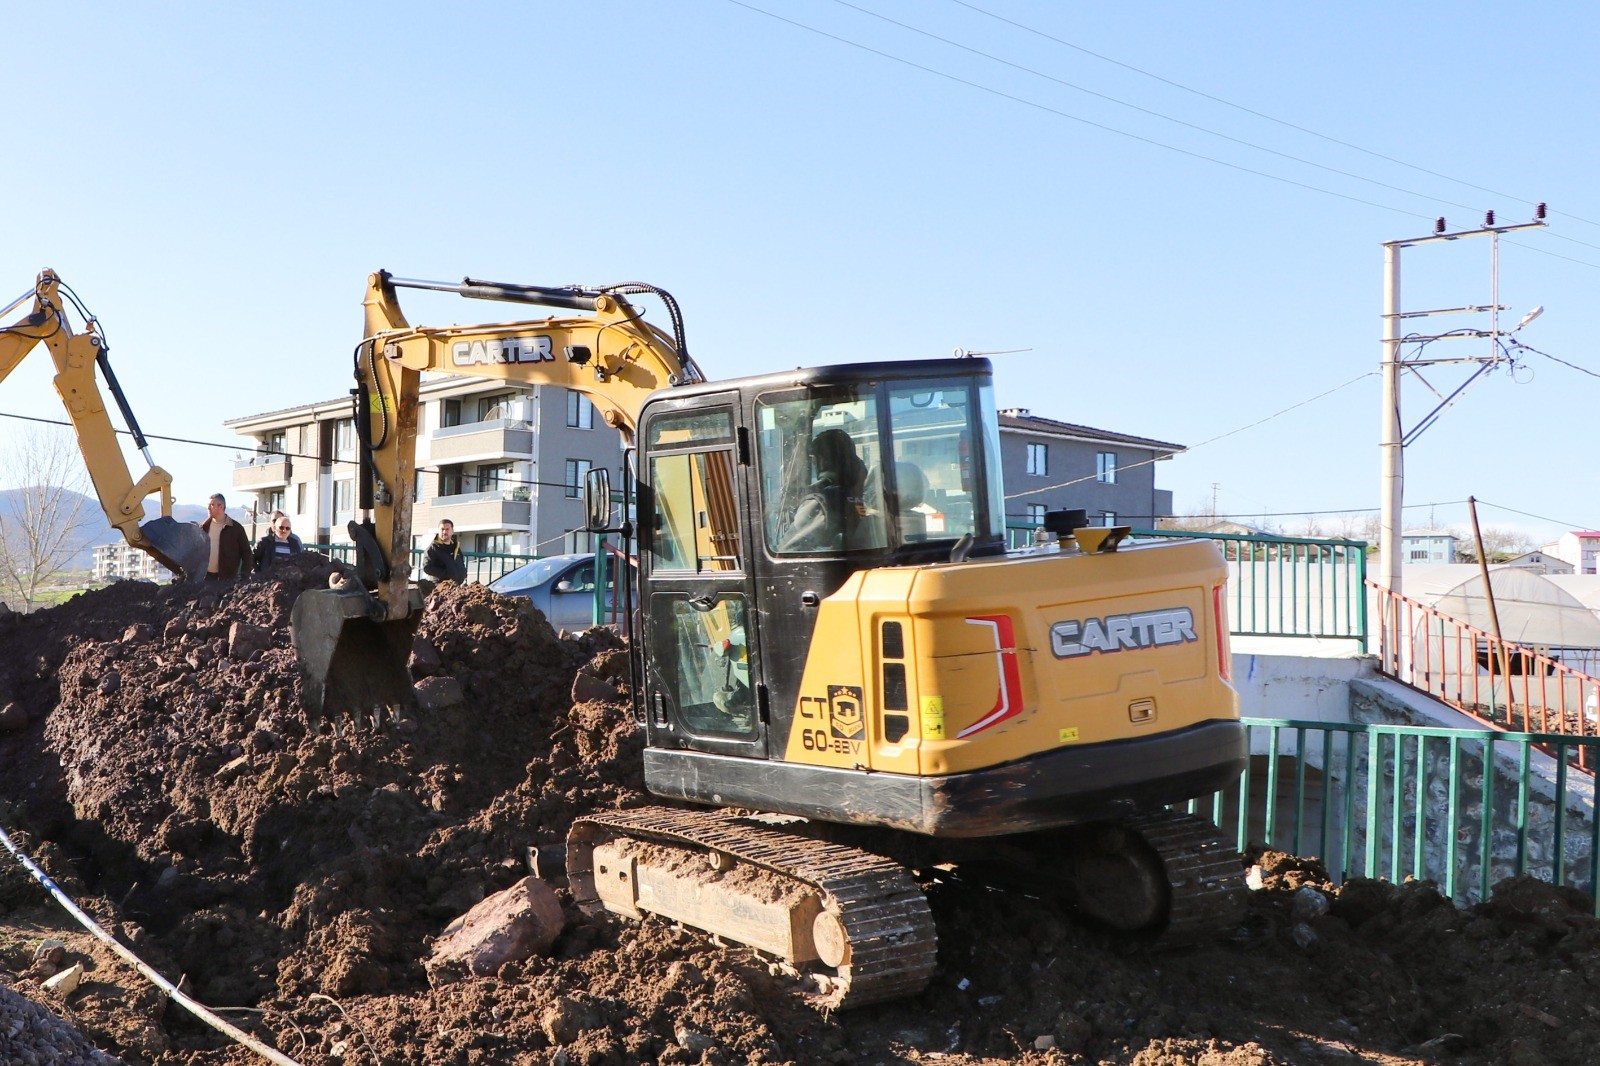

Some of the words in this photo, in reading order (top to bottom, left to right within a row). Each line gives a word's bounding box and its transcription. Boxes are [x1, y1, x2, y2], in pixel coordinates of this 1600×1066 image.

[453, 335, 555, 366] CARTER
[1049, 607, 1198, 660] CARTER
[800, 696, 827, 720] CT
